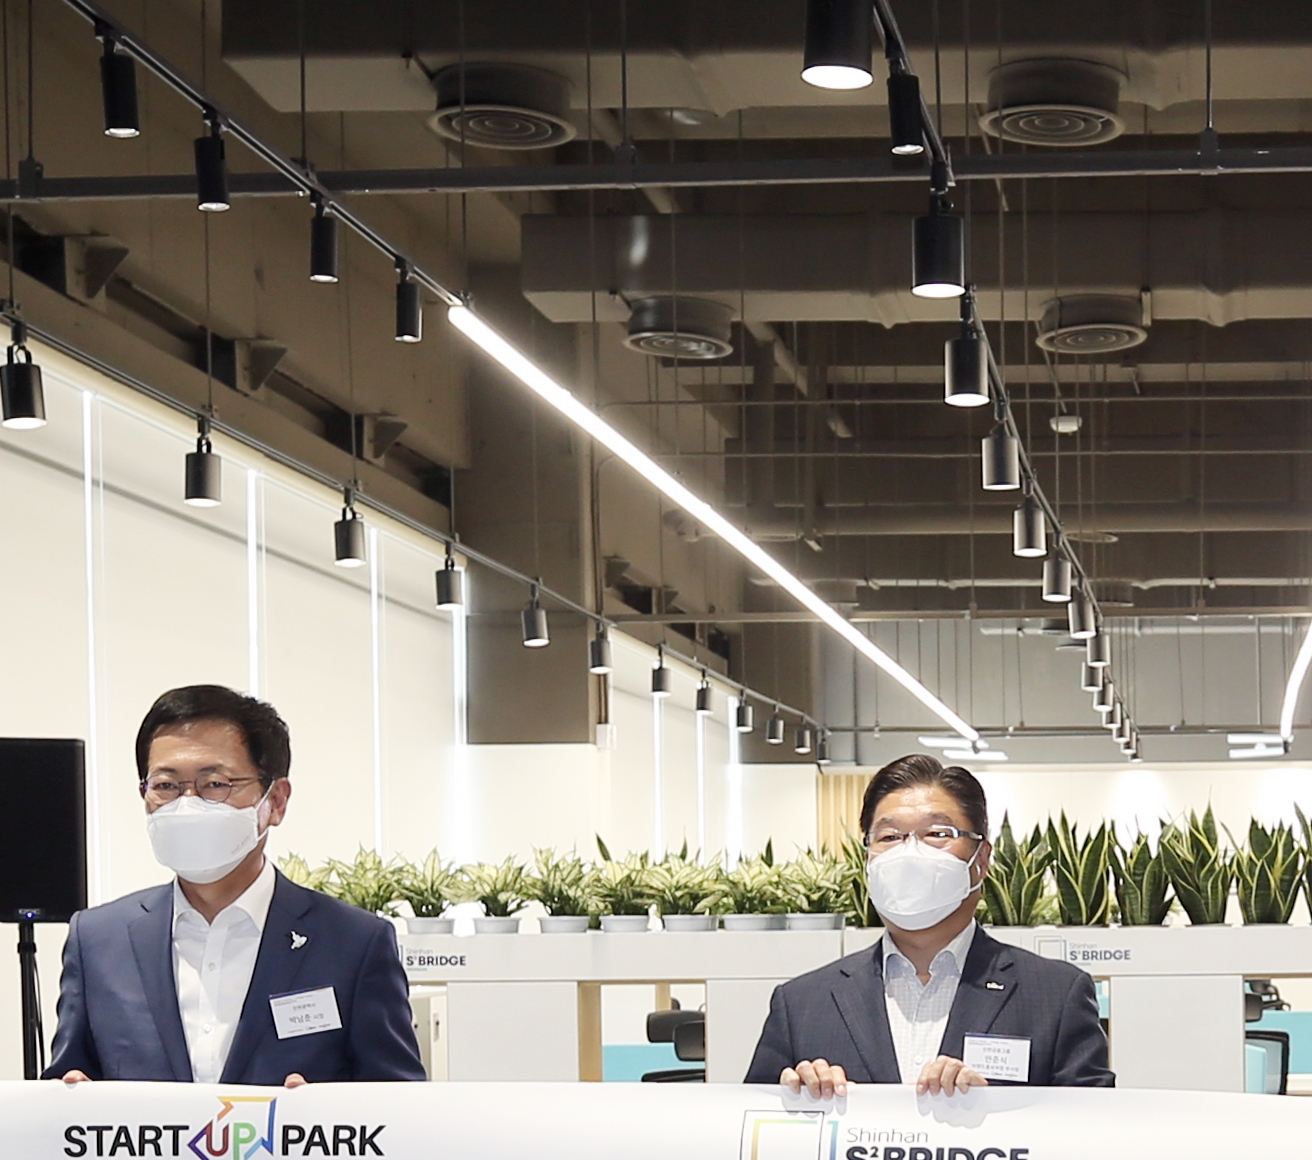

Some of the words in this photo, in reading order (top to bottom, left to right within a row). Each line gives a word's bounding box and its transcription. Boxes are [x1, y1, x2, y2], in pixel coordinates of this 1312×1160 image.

[64, 1124, 190, 1157] START
[281, 1124, 386, 1157] PARK
[846, 1127, 929, 1144] Shinhan
